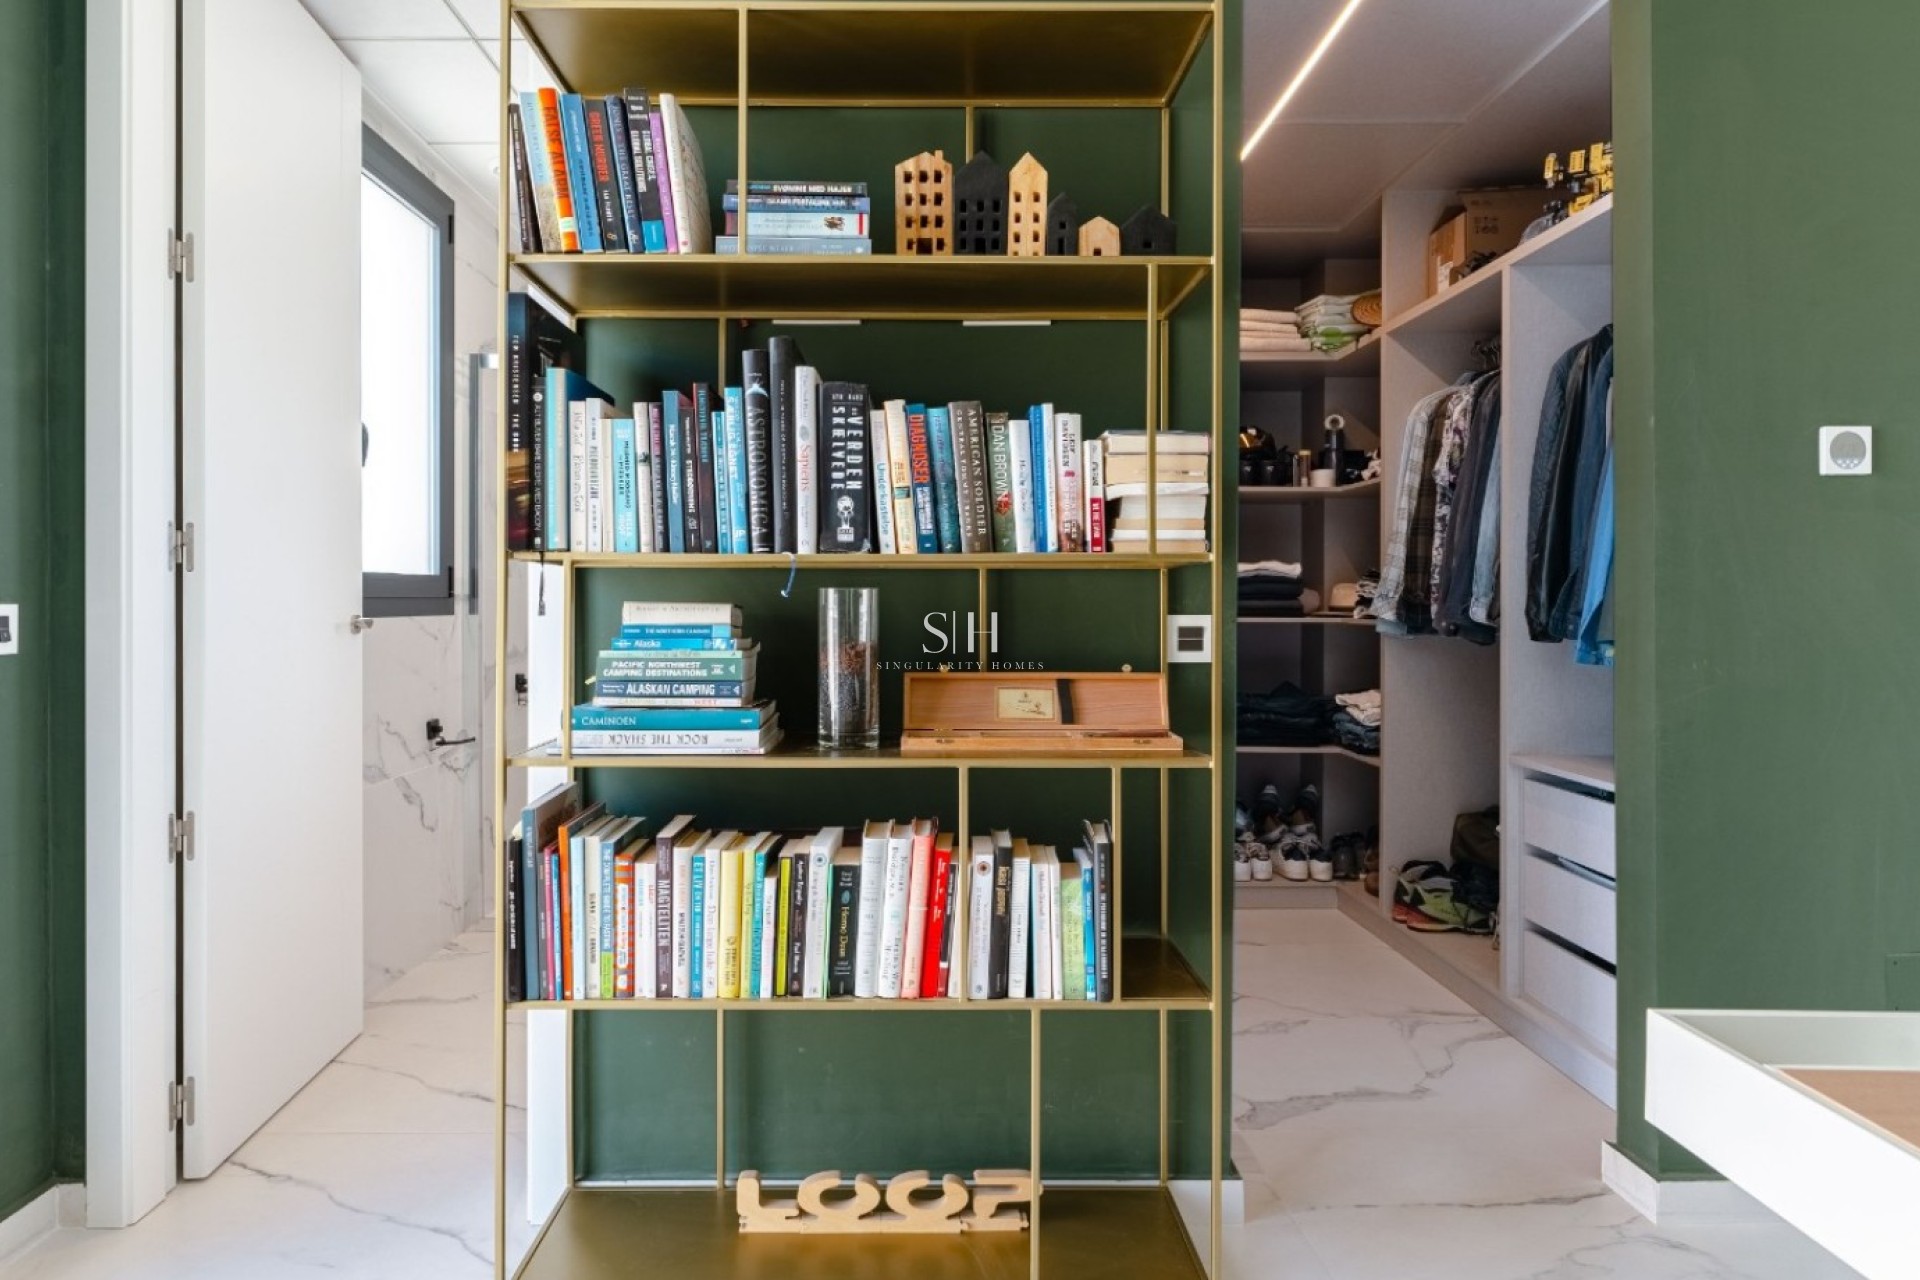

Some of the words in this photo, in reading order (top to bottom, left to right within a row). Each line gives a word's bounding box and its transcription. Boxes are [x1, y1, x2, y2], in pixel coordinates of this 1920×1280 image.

[544, 106, 561, 143] FALSE
[589, 111, 606, 142] GREEN
[612, 105, 623, 132] JONES
[594, 144, 609, 182] MURDER
[620, 164, 632, 190] GREAT
[626, 194, 635, 219] RESET
[846, 416, 863, 490] VERDEN
[910, 414, 930, 483] DIAGNOSER
[968, 409, 981, 476] AMERICAN
[992, 425, 1006, 451] DAN
[747, 407, 769, 536] ASTRONOMICA
[798, 444, 812, 492] Sapiens
[994, 454, 1009, 502] BROWN
[877, 463, 889, 535] Underkastelse
[974, 480, 986, 535] SOLDIER
[634, 640, 662, 648] Alaska
[603, 669, 644, 677] CAMPING
[646, 669, 708, 677] DESTINATIONS
[626, 683, 671, 695] ALASKAN
[673, 683, 715, 695] CAMPING
[582, 716, 636, 725] CAMINOEN
[608, 735, 647, 745] SHACK
[652, 735, 671, 745] THE
[676, 735, 709, 744] ROCK
[657, 879, 670, 946] MAGTELITEN
[840, 906, 849, 934] Homo
[839, 936, 848, 958] Deus
[736, 1169, 1044, 1220] LOOP
